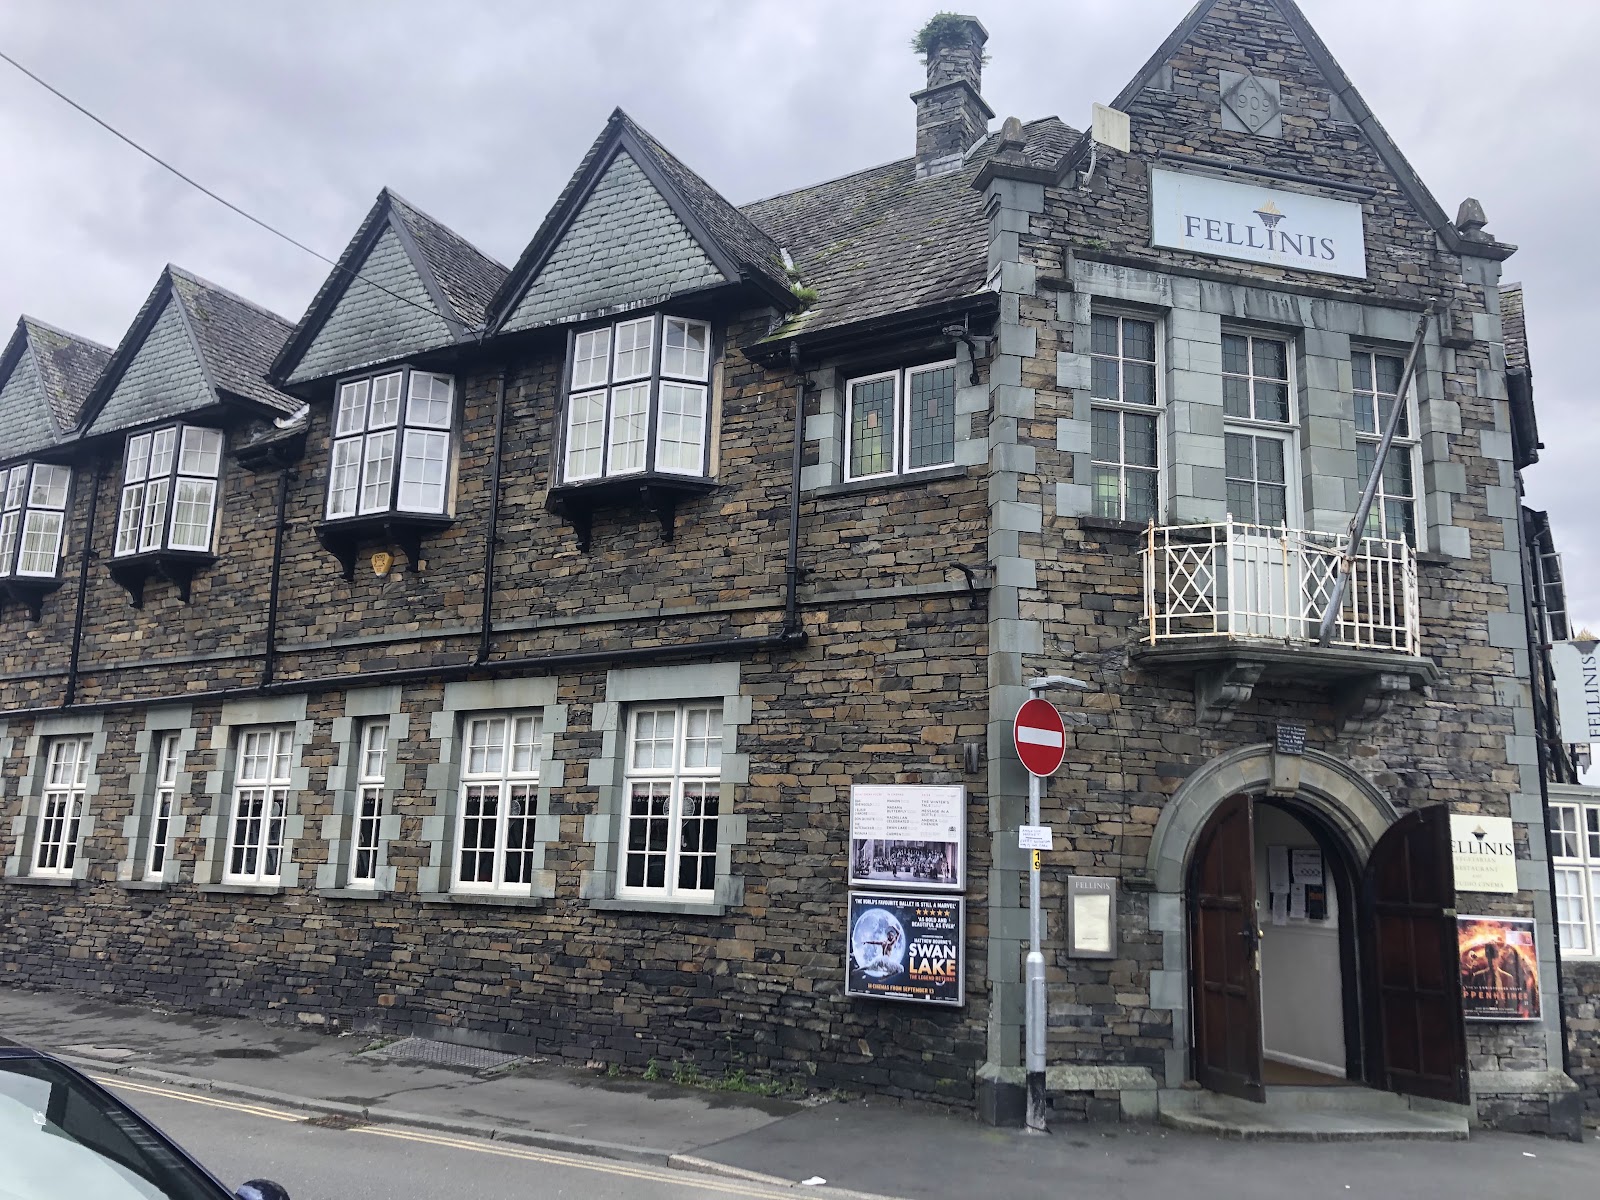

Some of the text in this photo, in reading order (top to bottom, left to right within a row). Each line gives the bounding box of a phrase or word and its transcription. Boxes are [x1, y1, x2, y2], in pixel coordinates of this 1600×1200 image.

[1184, 215, 1335, 260] FELLINIS
[1582, 656, 1600, 738] FELLINIS
[1450, 840, 1513, 856] ELLINIS
[1075, 881, 1110, 890] FELLINIS
[909, 944, 956, 959] SWAN
[910, 957, 956, 976] LAKE
[1463, 991, 1528, 1000] PPENHEIMER
